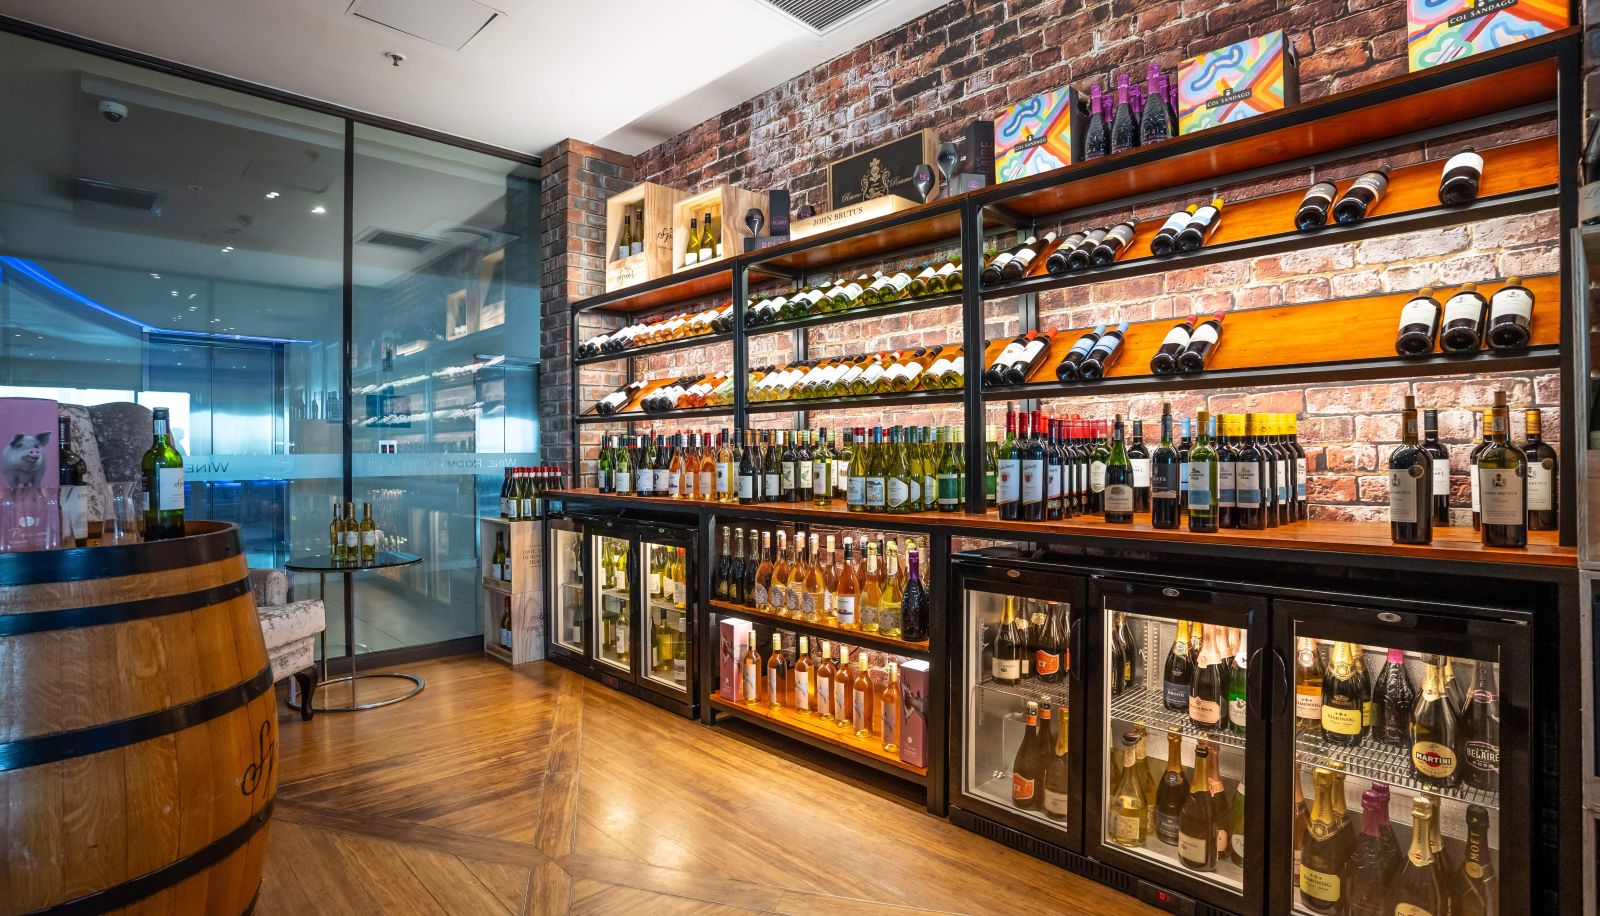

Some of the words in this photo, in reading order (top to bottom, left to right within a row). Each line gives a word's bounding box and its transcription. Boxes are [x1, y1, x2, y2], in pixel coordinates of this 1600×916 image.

[1450, 14, 1467, 24] COL
[1470, 0, 1515, 18] SANDAGO
[1220, 91, 1251, 104] SANDAGO
[1025, 137, 1047, 148] SANDAGO
[813, 215, 833, 227] JOHN
[834, 207, 863, 220] BRUTUS
[1416, 752, 1451, 766] MARTINI
[1466, 747, 1499, 762] BELAIRE
